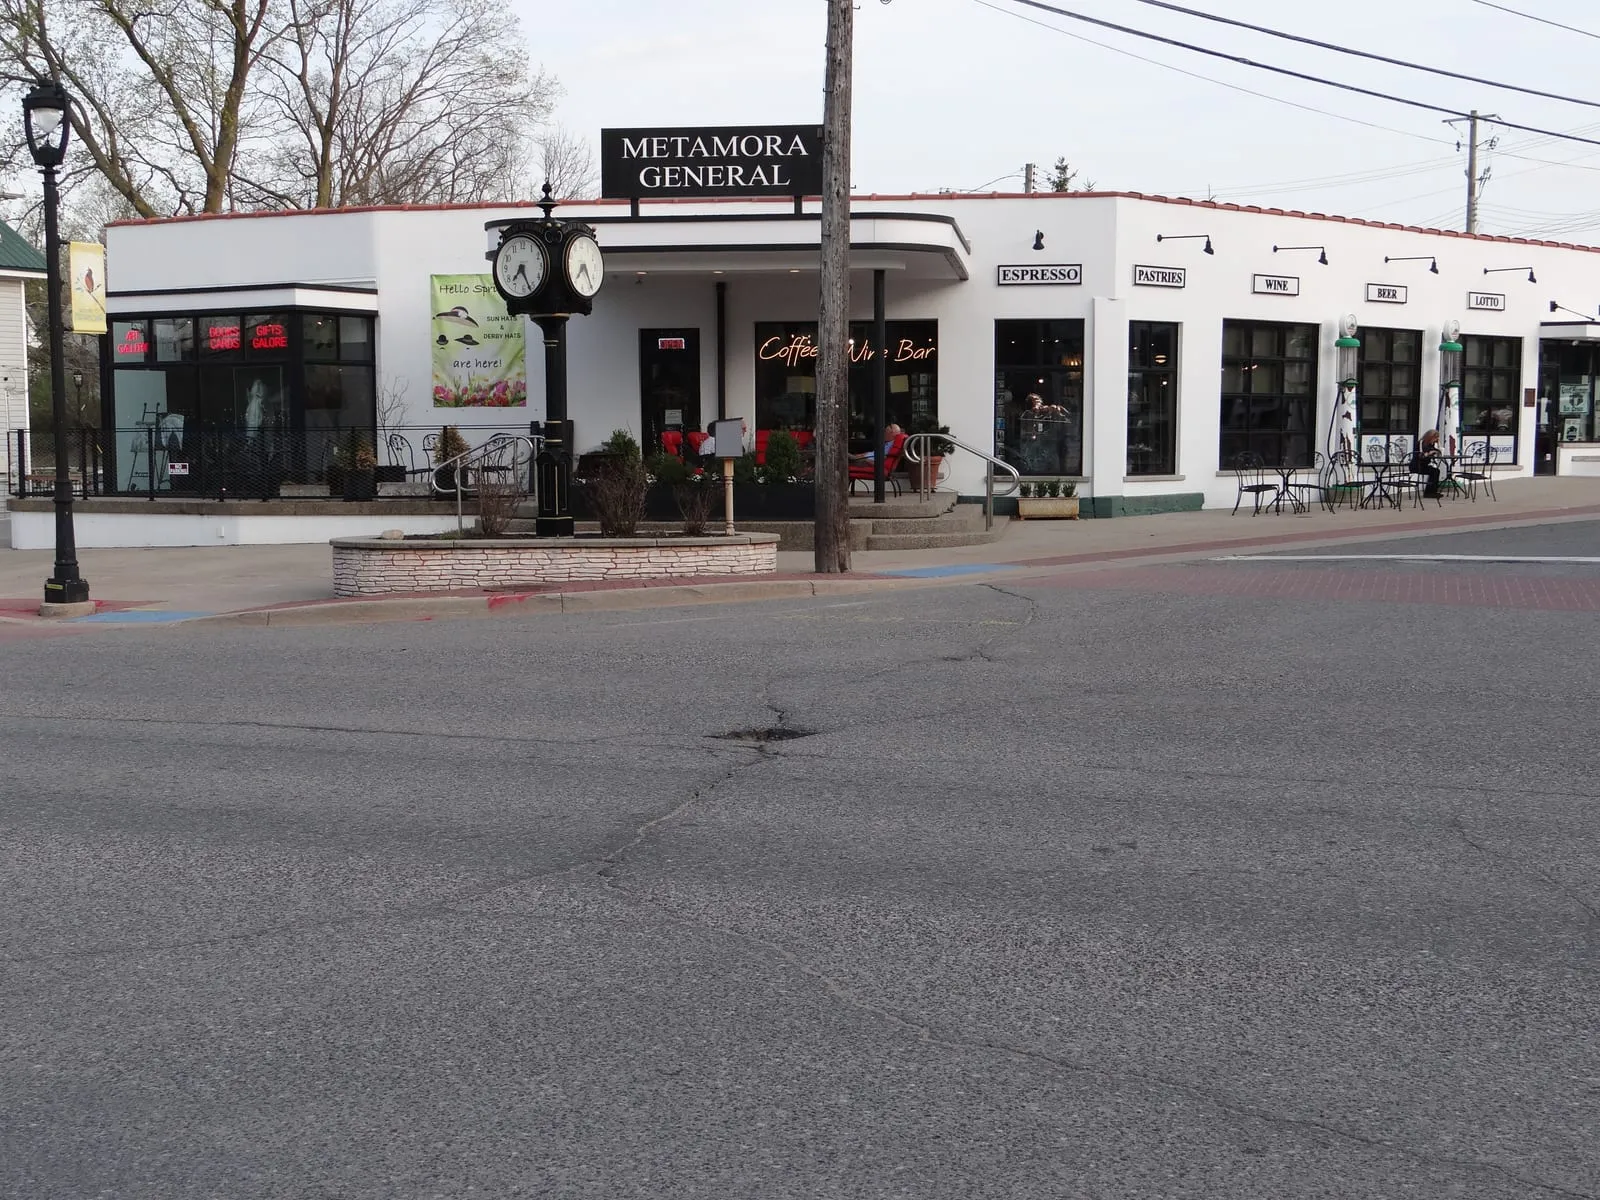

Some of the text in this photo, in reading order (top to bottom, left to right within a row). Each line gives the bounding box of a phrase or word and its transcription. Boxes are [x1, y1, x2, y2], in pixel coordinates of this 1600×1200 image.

[621, 134, 809, 159] METAMORA
[639, 164, 791, 188] GENERAL
[1002, 268, 1079, 282] ESPRESSO
[1137, 269, 1183, 284] PASTRIES
[439, 284, 497, 297] Hello Spri
[1265, 279, 1289, 291] WINE
[1377, 288, 1397, 299] BEER
[1475, 295, 1499, 307] LOTTO
[256, 325, 283, 336] GIFTS
[252, 337, 288, 348] GALORE
[760, 335, 818, 367] Coffee
[894, 339, 936, 361] Bar
[453, 359, 502, 368] are here!
